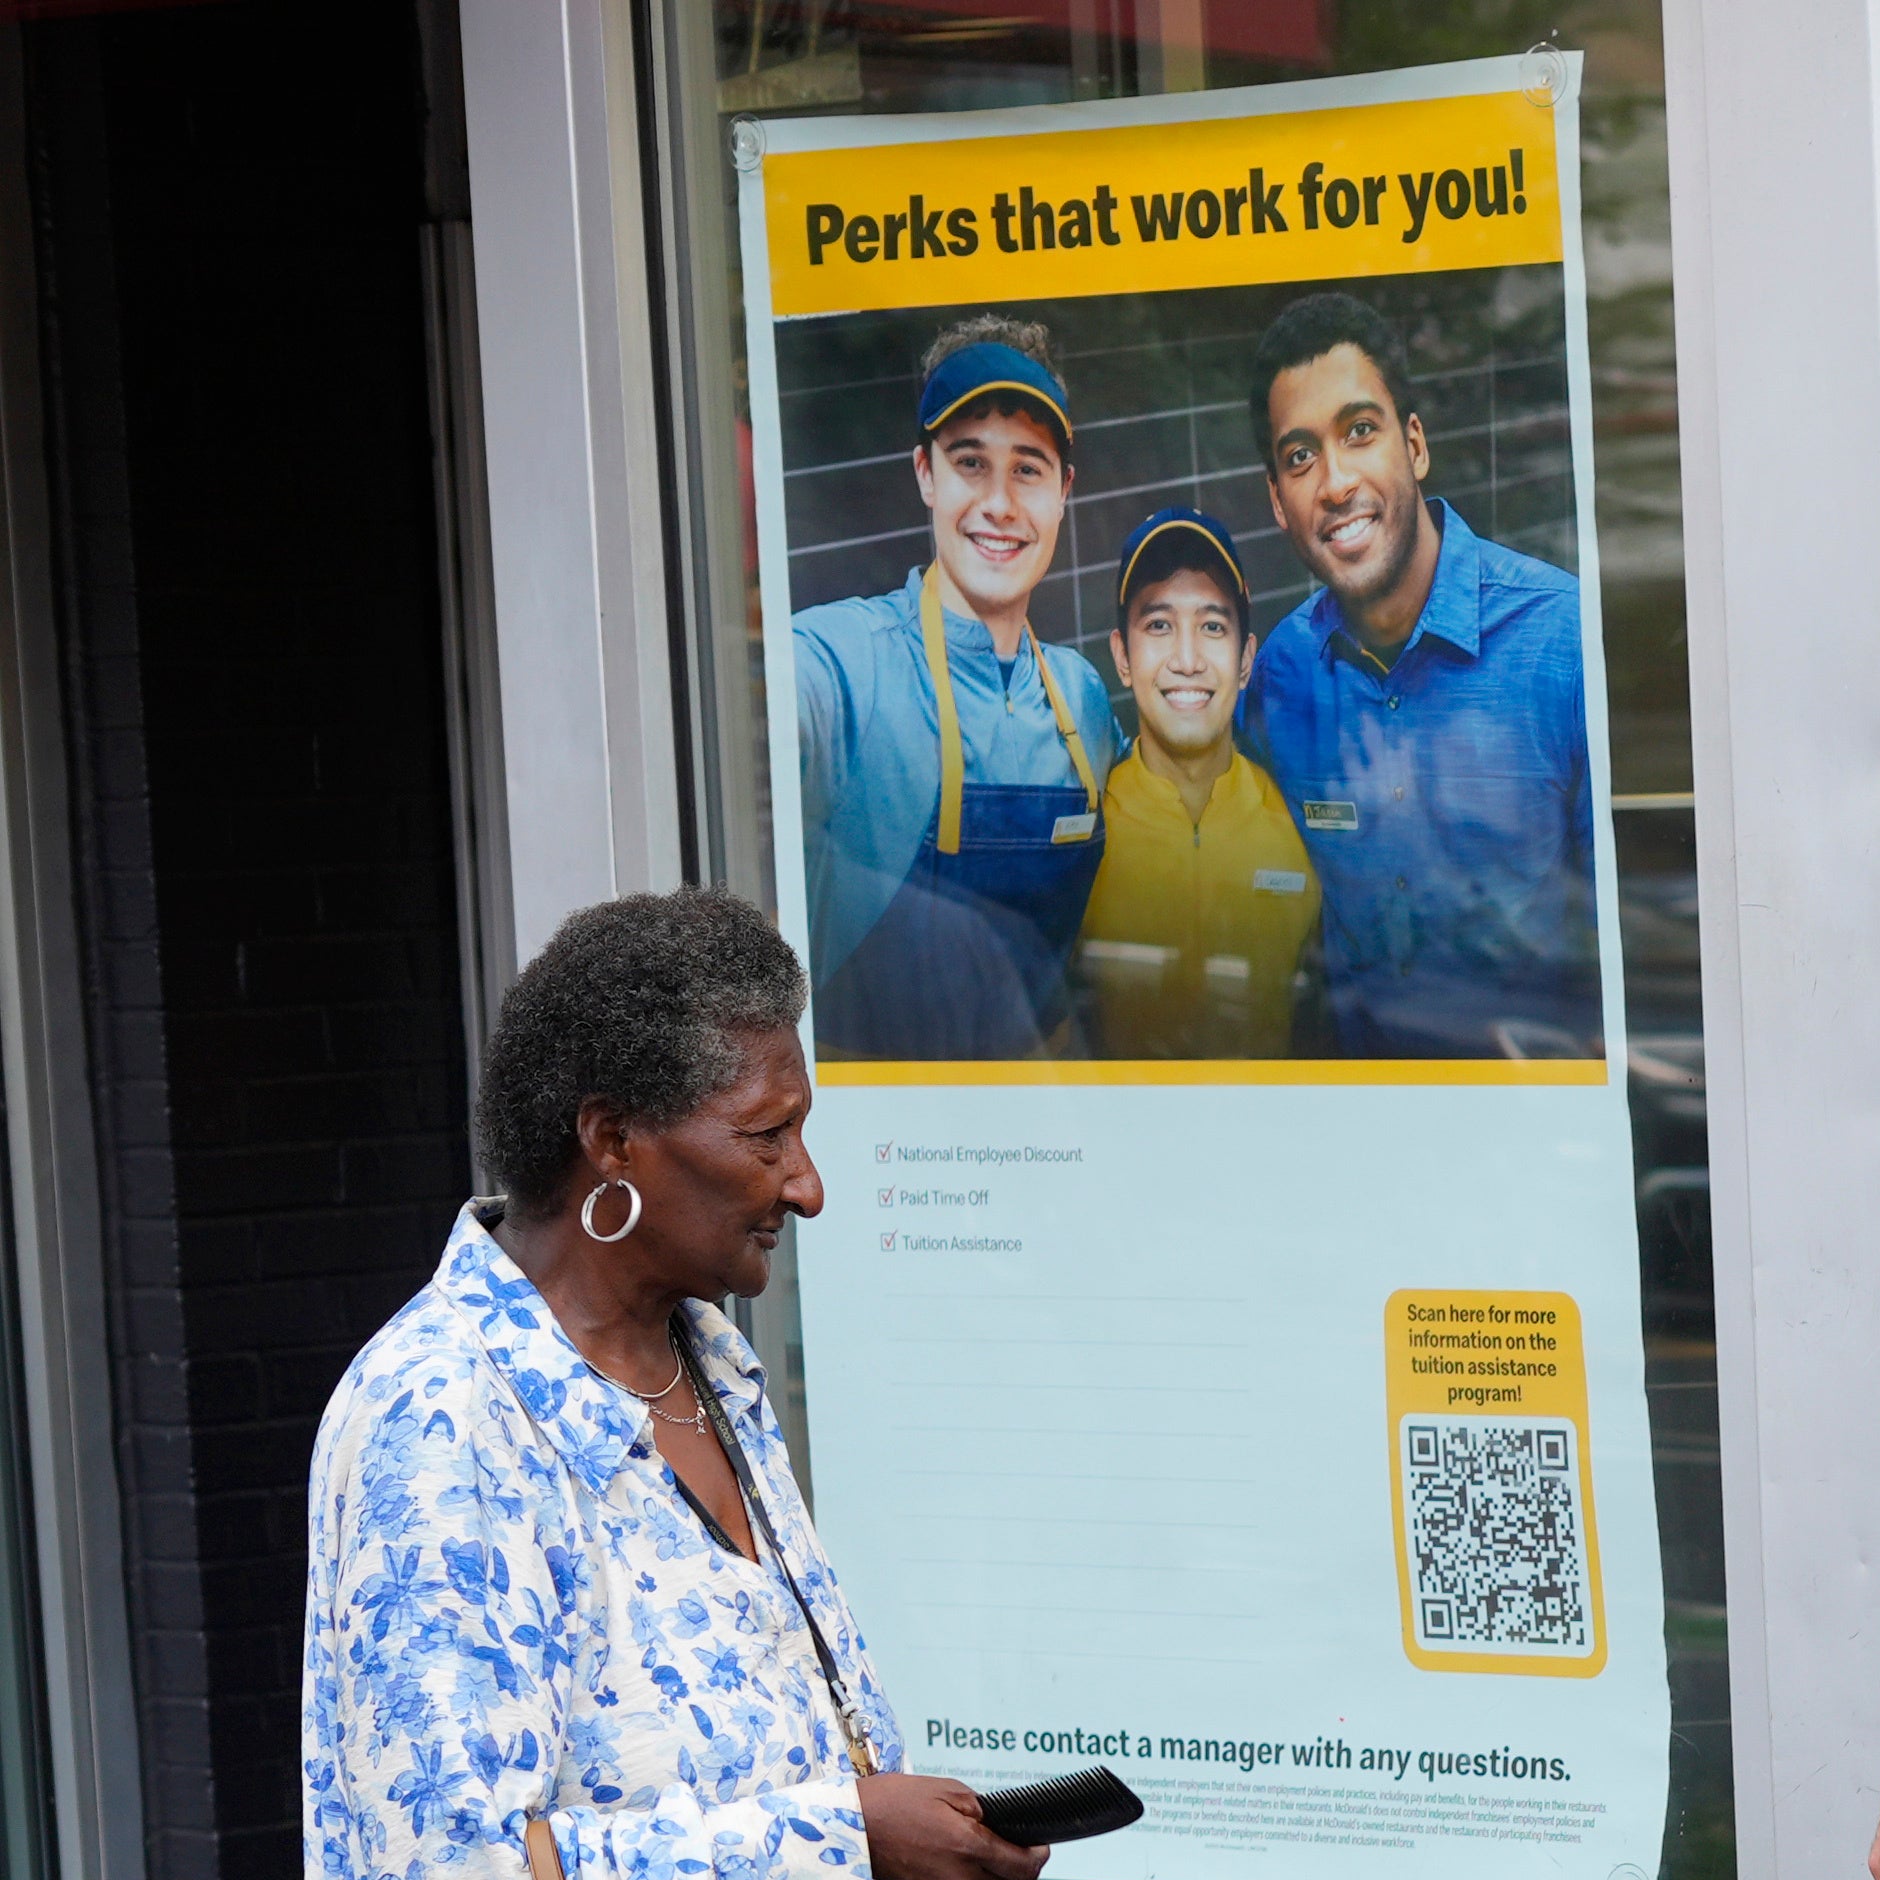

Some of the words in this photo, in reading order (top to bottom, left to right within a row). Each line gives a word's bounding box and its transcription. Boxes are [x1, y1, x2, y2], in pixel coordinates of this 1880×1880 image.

[805, 196, 980, 267] Perks
[991, 185, 1121, 255] that
[1130, 167, 1288, 243] work
[1297, 162, 1388, 229] for
[1397, 149, 1527, 244] you!
[898, 1147, 953, 1162] National
[957, 1147, 1021, 1166] Employee
[1024, 1147, 1083, 1162] Discount
[900, 1190, 928, 1206] Paid
[932, 1190, 965, 1205] Time
[968, 1190, 988, 1206] Off
[902, 1235, 948, 1250] Tuition
[951, 1236, 1022, 1252] Assistance
[1408, 1304, 1445, 1322] Scan
[1450, 1305, 1484, 1323] here
[1489, 1306, 1510, 1323] for
[1515, 1310, 1556, 1324] more
[1409, 1329, 1501, 1349] information
[1506, 1336, 1525, 1350] on
[1529, 1333, 1556, 1350] the
[1412, 1356, 1464, 1374] tuition
[1468, 1358, 1556, 1376] assistance
[1448, 1386, 1521, 1405] program!
[716, 1417, 736, 1446] School
[926, 1719, 1016, 1751] Please
[1024, 1730, 1130, 1758] contact
[1137, 1737, 1152, 1759] a
[1160, 1739, 1286, 1772] manager
[1291, 1739, 1352, 1769] with
[1360, 1748, 1411, 1780] any
[1417, 1745, 1572, 1786] questions.
[1379, 1790, 1409, 1803] including
[1490, 1797, 1514, 1809] people
[1515, 1798, 1542, 1811] working
[1428, 1808, 1469, 1821] independent
[1512, 1813, 1554, 1826] employment
[1555, 1815, 1580, 1828] policies
[1351, 1834, 1379, 1845] inclusive
[1386, 1821, 1424, 1832] restaurants
[1451, 1826, 1489, 1836] restaurants
[1498, 1829, 1541, 1842] participating
